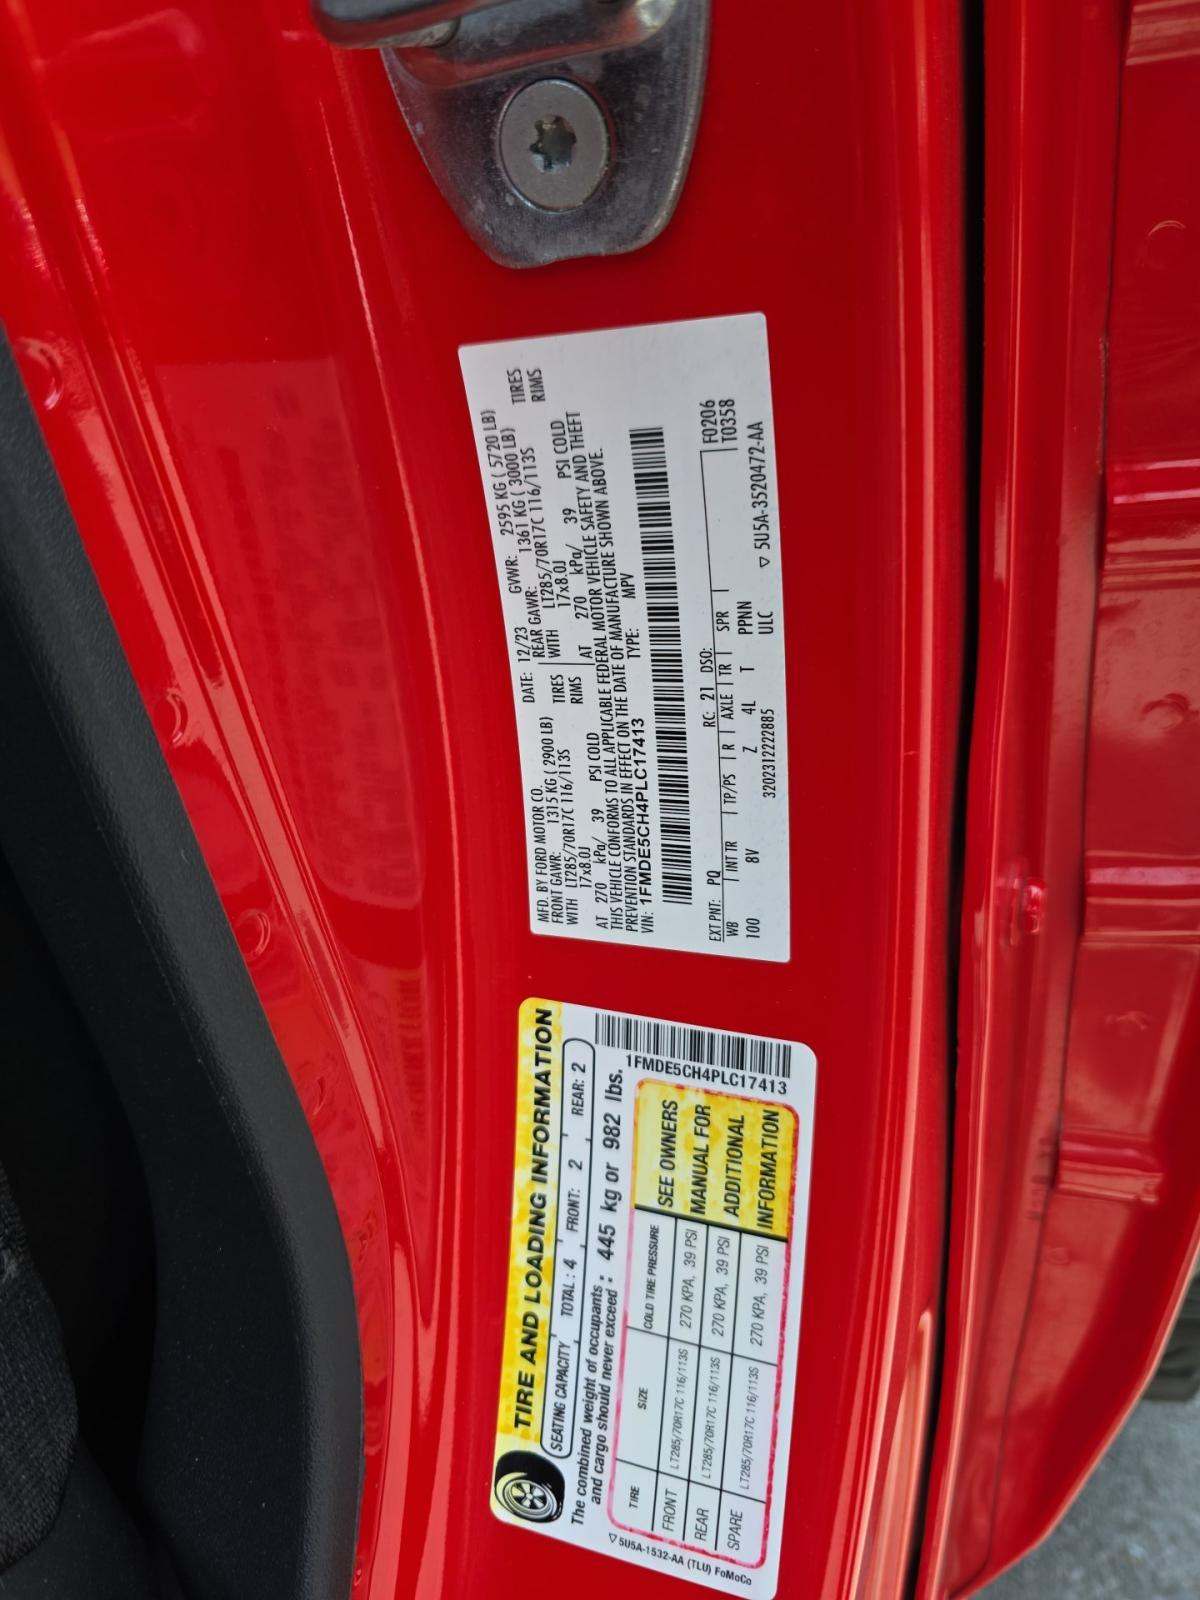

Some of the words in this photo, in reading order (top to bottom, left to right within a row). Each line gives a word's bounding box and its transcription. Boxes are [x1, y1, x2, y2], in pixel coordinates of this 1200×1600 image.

[506, 368, 525, 404] TIRES
[526, 367, 545, 402] RIMS
[565, 411, 584, 451] THEFT
[699, 399, 718, 443] F0206
[718, 398, 737, 443] T0358
[550, 420, 568, 454] COLD
[519, 447, 542, 512] 116/113S
[555, 459, 571, 478] PSI
[571, 454, 589, 482] AND
[588, 448, 607, 495] ABOVE.
[746, 421, 770, 549] 5U5A-3520472-AA
[495, 504, 514, 535] 2595
[561, 507, 577, 524] 39
[575, 486, 595, 531] SAFETY
[594, 500, 613, 547] SHOWN
[515, 523, 532, 553] 1361
[530, 517, 555, 608] LT285/70R17C
[565, 543, 583, 574] kPa/
[580, 535, 601, 584] VEHICLE
[504, 555, 522, 593] GVWR:
[551, 560, 571, 607] 17x8.0J
[619, 572, 635, 598] MPV
[524, 586, 541, 624] GAWR:
[572, 596, 588, 619] 270
[588, 588, 605, 631] MOTOR
[600, 552, 622, 640] MANUFACTURE
[715, 611, 729, 631] SPR
[736, 601, 753, 634] PPNN
[756, 611, 773, 634] ULC
[513, 626, 531, 662] 12/23
[529, 629, 545, 657] REAR
[545, 629, 560, 658] WITH
[578, 644, 593, 658] AT
[609, 645, 624, 660] OF
[624, 628, 640, 659] TYPE:
[592, 635, 610, 683] FEDERAL
[699, 647, 713, 672] DSO:
[718, 663, 732, 676] TR
[519, 672, 535, 702] DATE:
[549, 674, 565, 703] TIRES
[567, 676, 583, 704] RIMS
[611, 664, 626, 692] DATE
[613, 696, 628, 716] THE
[699, 687, 714, 700] 21
[719, 693, 733, 719] AXLE
[740, 700, 755, 714] 4L
[538, 716, 553, 734] LB)
[597, 688, 615, 754] APPLICABLE
[615, 721, 629, 737] ON
[702, 711, 715, 727] RC:
[586, 732, 600, 761] COLD
[617, 741, 632, 778] EFFECT
[760, 708, 775, 798] 3202312222885
[556, 749, 573, 802] 116/113S
[588, 765, 602, 781] PSI
[603, 759, 617, 776] ALL
[530, 785, 543, 802] CO.
[543, 778, 557, 793] KG
[604, 779, 617, 793] TO
[619, 782, 633, 794] IN
[721, 773, 737, 804] TP/PS
[531, 805, 545, 844] MOTOR
[545, 796, 559, 823] 1315
[590, 808, 604, 822] 39
[630, 718, 652, 905] 1FMDE5CH4PLC17413
[605, 797, 621, 856] CONFORMS
[620, 798, 636, 862] STANDARDS
[534, 847, 547, 875] FORD
[560, 807, 577, 887] LT285/70R17C
[591, 836, 607, 864] kPa/
[724, 840, 737, 852] TR
[744, 848, 759, 863] 8V
[548, 851, 562, 885] GAWR:
[577, 846, 592, 888] 17x8.0J
[706, 870, 721, 885] PQ
[724, 854, 738, 872] INT
[535, 878, 548, 892] BY
[594, 882, 608, 903] 270
[608, 860, 622, 903] VEHICLE
[536, 896, 549, 922] MFD.
[550, 889, 563, 923] FRONT
[565, 898, 578, 925] WITH
[623, 865, 638, 932] PREVENTION
[708, 899, 721, 921] PNT:
[595, 915, 608, 929] AT
[609, 907, 623, 929] THIS
[640, 911, 653, 933] VIN:
[708, 923, 721, 941] EXT
[725, 921, 738, 936] WB
[745, 917, 760, 938] 100
[571, 1062, 585, 1073] 2
[626, 1053, 786, 1094] 1FMDE5CH4PLC17413
[531, 1008, 552, 1183] INFORMATION
[571, 1078, 584, 1115] REAR:
[604, 1069, 622, 1101] lbs.
[602, 1112, 620, 1149] 982
[659, 1099, 678, 1170] OWNERS
[693, 1104, 710, 1137] FOR
[567, 1159, 582, 1170] 2
[604, 1161, 618, 1182] or
[689, 1144, 709, 1214] MANUAL
[723, 1114, 744, 1217] ADDITIONAL
[756, 1109, 779, 1229] INFORMATION
[600, 1188, 621, 1212] kg
[657, 1175, 674, 1207] SEE
[565, 1187, 580, 1232] FRONT:
[523, 1192, 546, 1303] LOADING
[596, 1223, 615, 1260] 445
[647, 1224, 659, 1276] PRESSURE
[684, 1228, 697, 1247] PSI
[716, 1235, 730, 1256] PSI
[563, 1258, 577, 1269] 4
[683, 1251, 696, 1267] 39
[715, 1258, 728, 1275] 39
[645, 1277, 655, 1299] TIRE
[681, 1275, 695, 1301] KPA,
[713, 1283, 728, 1310] KPA,
[588, 1285, 603, 1355] occupants
[604, 1288, 617, 1337] exceed
[642, 1302, 654, 1329] COLD
[679, 1304, 692, 1328] 270
[711, 1312, 725, 1336] 270
[519, 1311, 538, 1365] AND
[554, 1340, 570, 1399] CAPACITY
[585, 1358, 597, 1373] of
[601, 1340, 613, 1380] never
[675, 1348, 688, 1394] 116/113S
[513, 1370, 534, 1428] TIRE
[581, 1377, 597, 1423] weight
[595, 1383, 610, 1431] should
[637, 1387, 648, 1409] SIZE
[550, 1401, 565, 1451] SEATING
[669, 1396, 684, 1469] LT285/70R17C
[576, 1426, 591, 1496] combined
[593, 1434, 608, 1474] cargo
[590, 1476, 602, 1504] and
[628, 1485, 639, 1508] TIRE
[570, 1500, 585, 1524] The
[661, 1487, 677, 1531] FRONT
[694, 1507, 709, 1541] REAR
[726, 1508, 742, 1550] SPARE
[618, 1537, 683, 1565] 5U5A-1532-AA
[686, 1558, 711, 1575] (TLU)
[714, 1566, 751, 1585] FoMoCo
